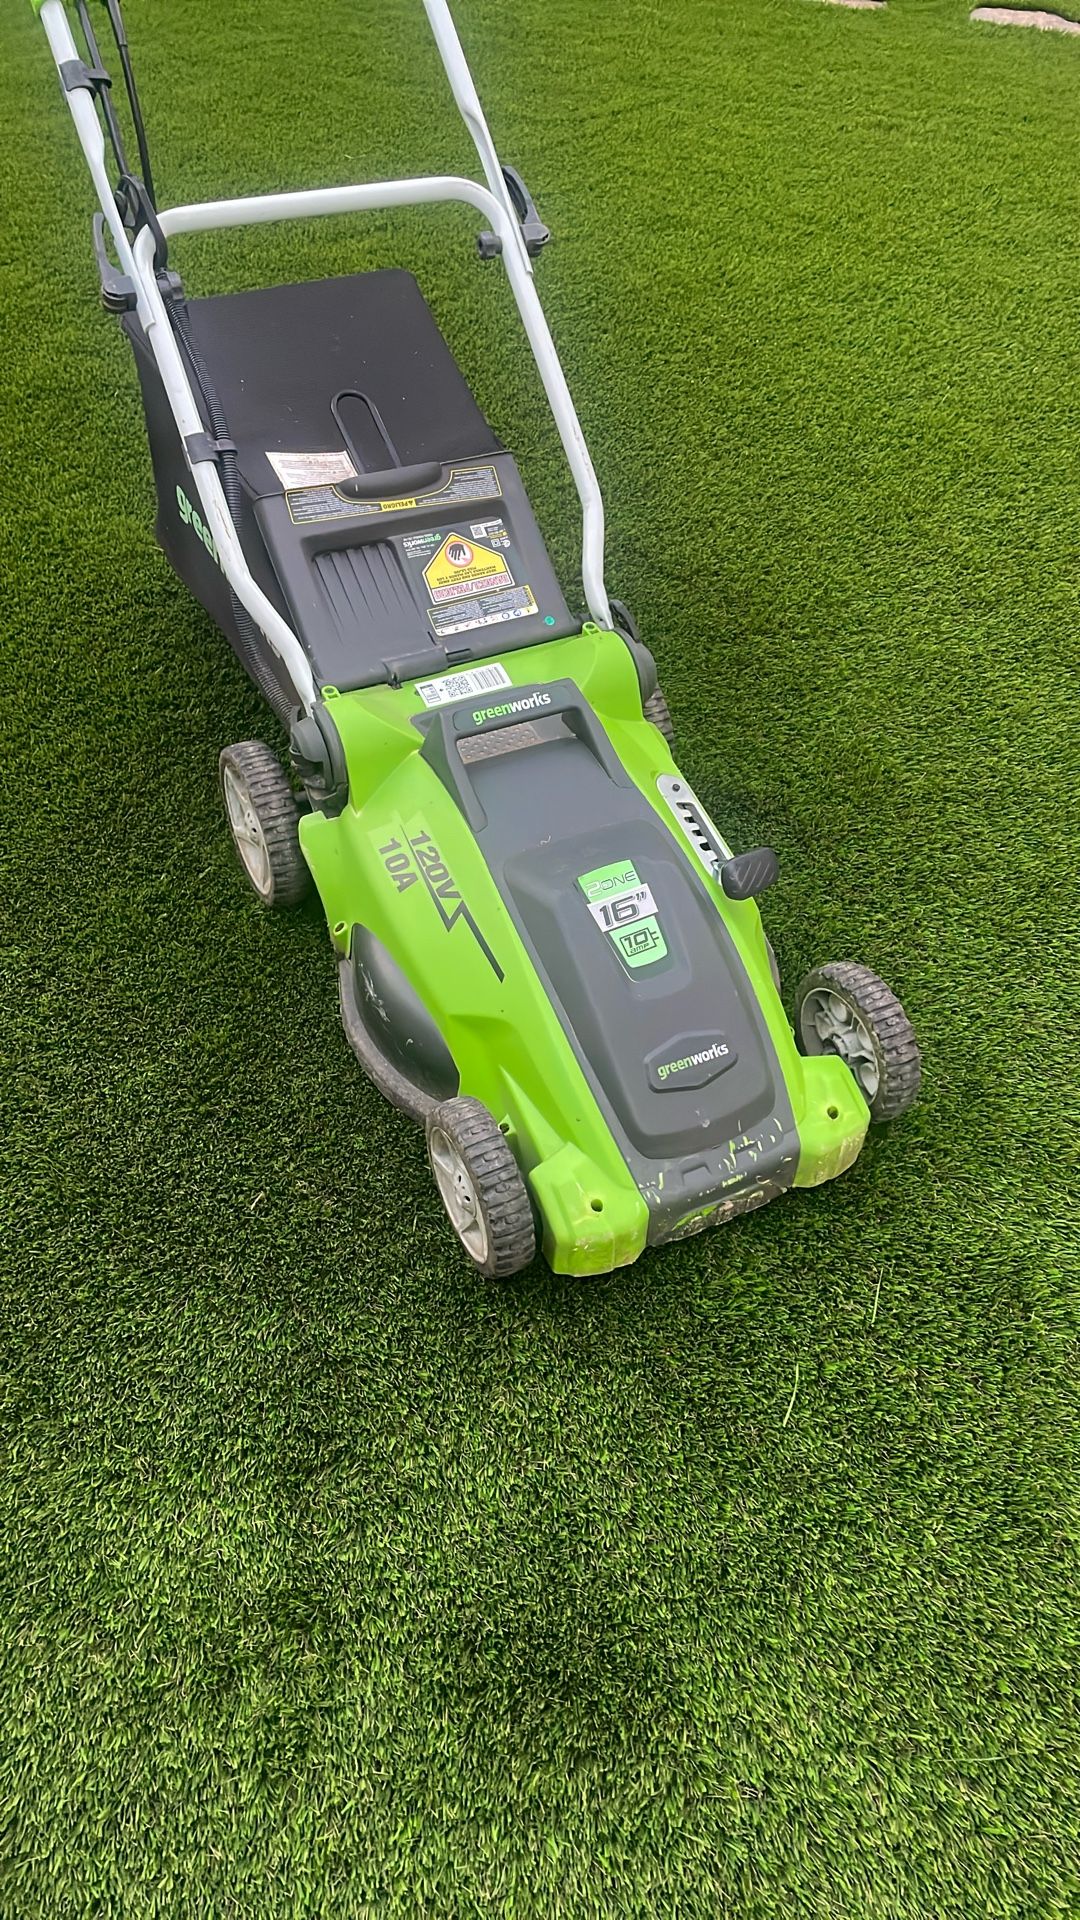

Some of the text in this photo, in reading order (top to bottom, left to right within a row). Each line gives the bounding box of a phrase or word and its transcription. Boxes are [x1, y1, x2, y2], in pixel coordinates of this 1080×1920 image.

[403, 533, 441, 548] greenworks
[472, 691, 551, 725] greenworks
[378, 837, 419, 893] 10A
[410, 830, 461, 899] 120V
[624, 930, 649, 948] 10
[657, 1043, 729, 1080] greenworks
